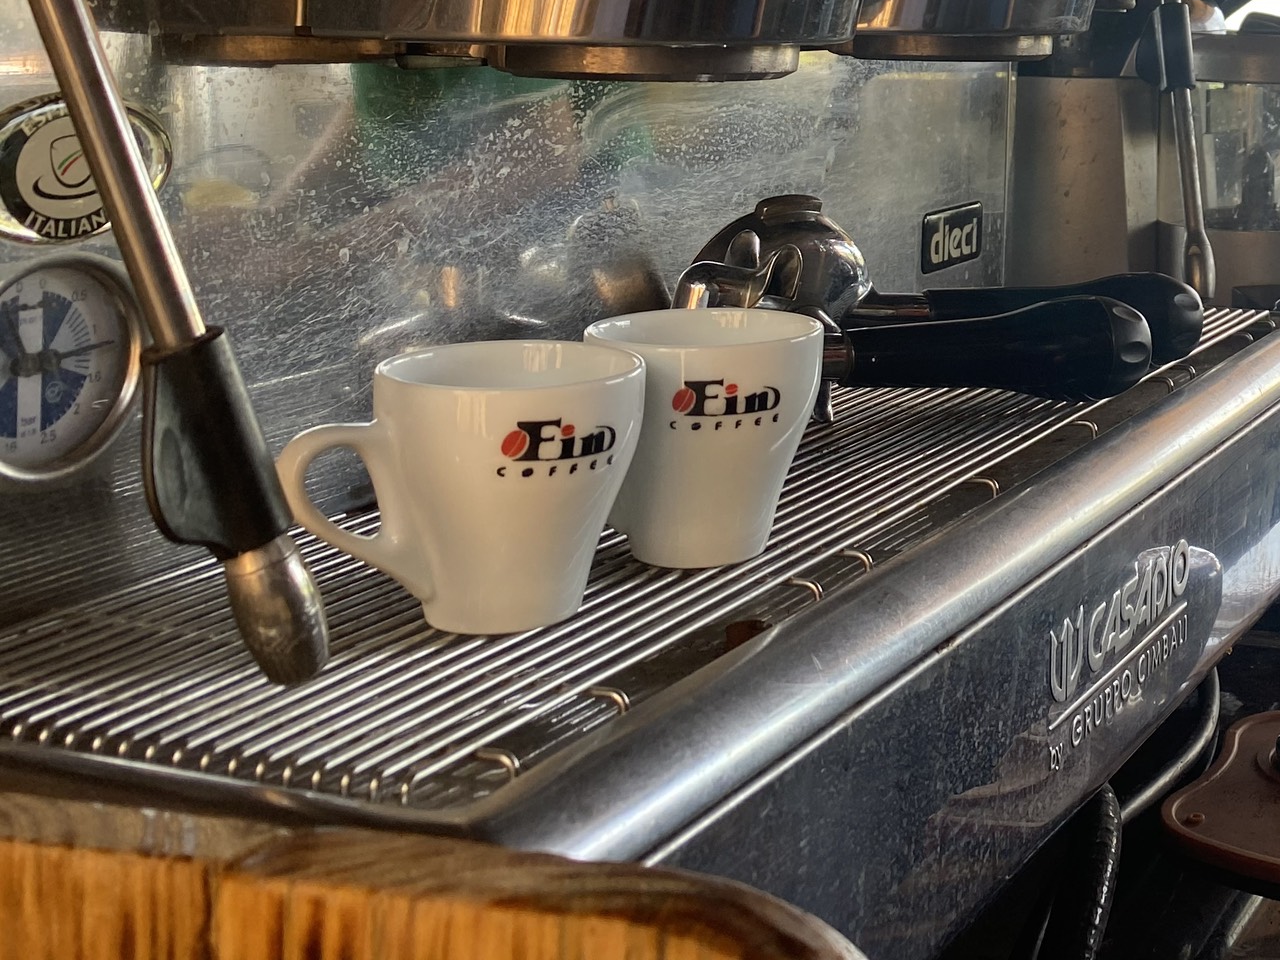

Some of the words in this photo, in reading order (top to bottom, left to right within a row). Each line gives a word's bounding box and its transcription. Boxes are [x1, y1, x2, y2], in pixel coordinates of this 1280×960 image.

[24, 209, 107, 238] ITALIAN
[931, 216, 978, 264] dieci
[683, 378, 781, 417] Fin
[511, 417, 617, 462] Fin
[669, 413, 780, 431] COFFEE
[496, 454, 614, 477] COFFEE
[1087, 539, 1190, 673] CASADIO
[1049, 742, 1063, 771] by
[1071, 669, 1131, 748] GRUPPO
[1138, 614, 1189, 684] CIMBALI
